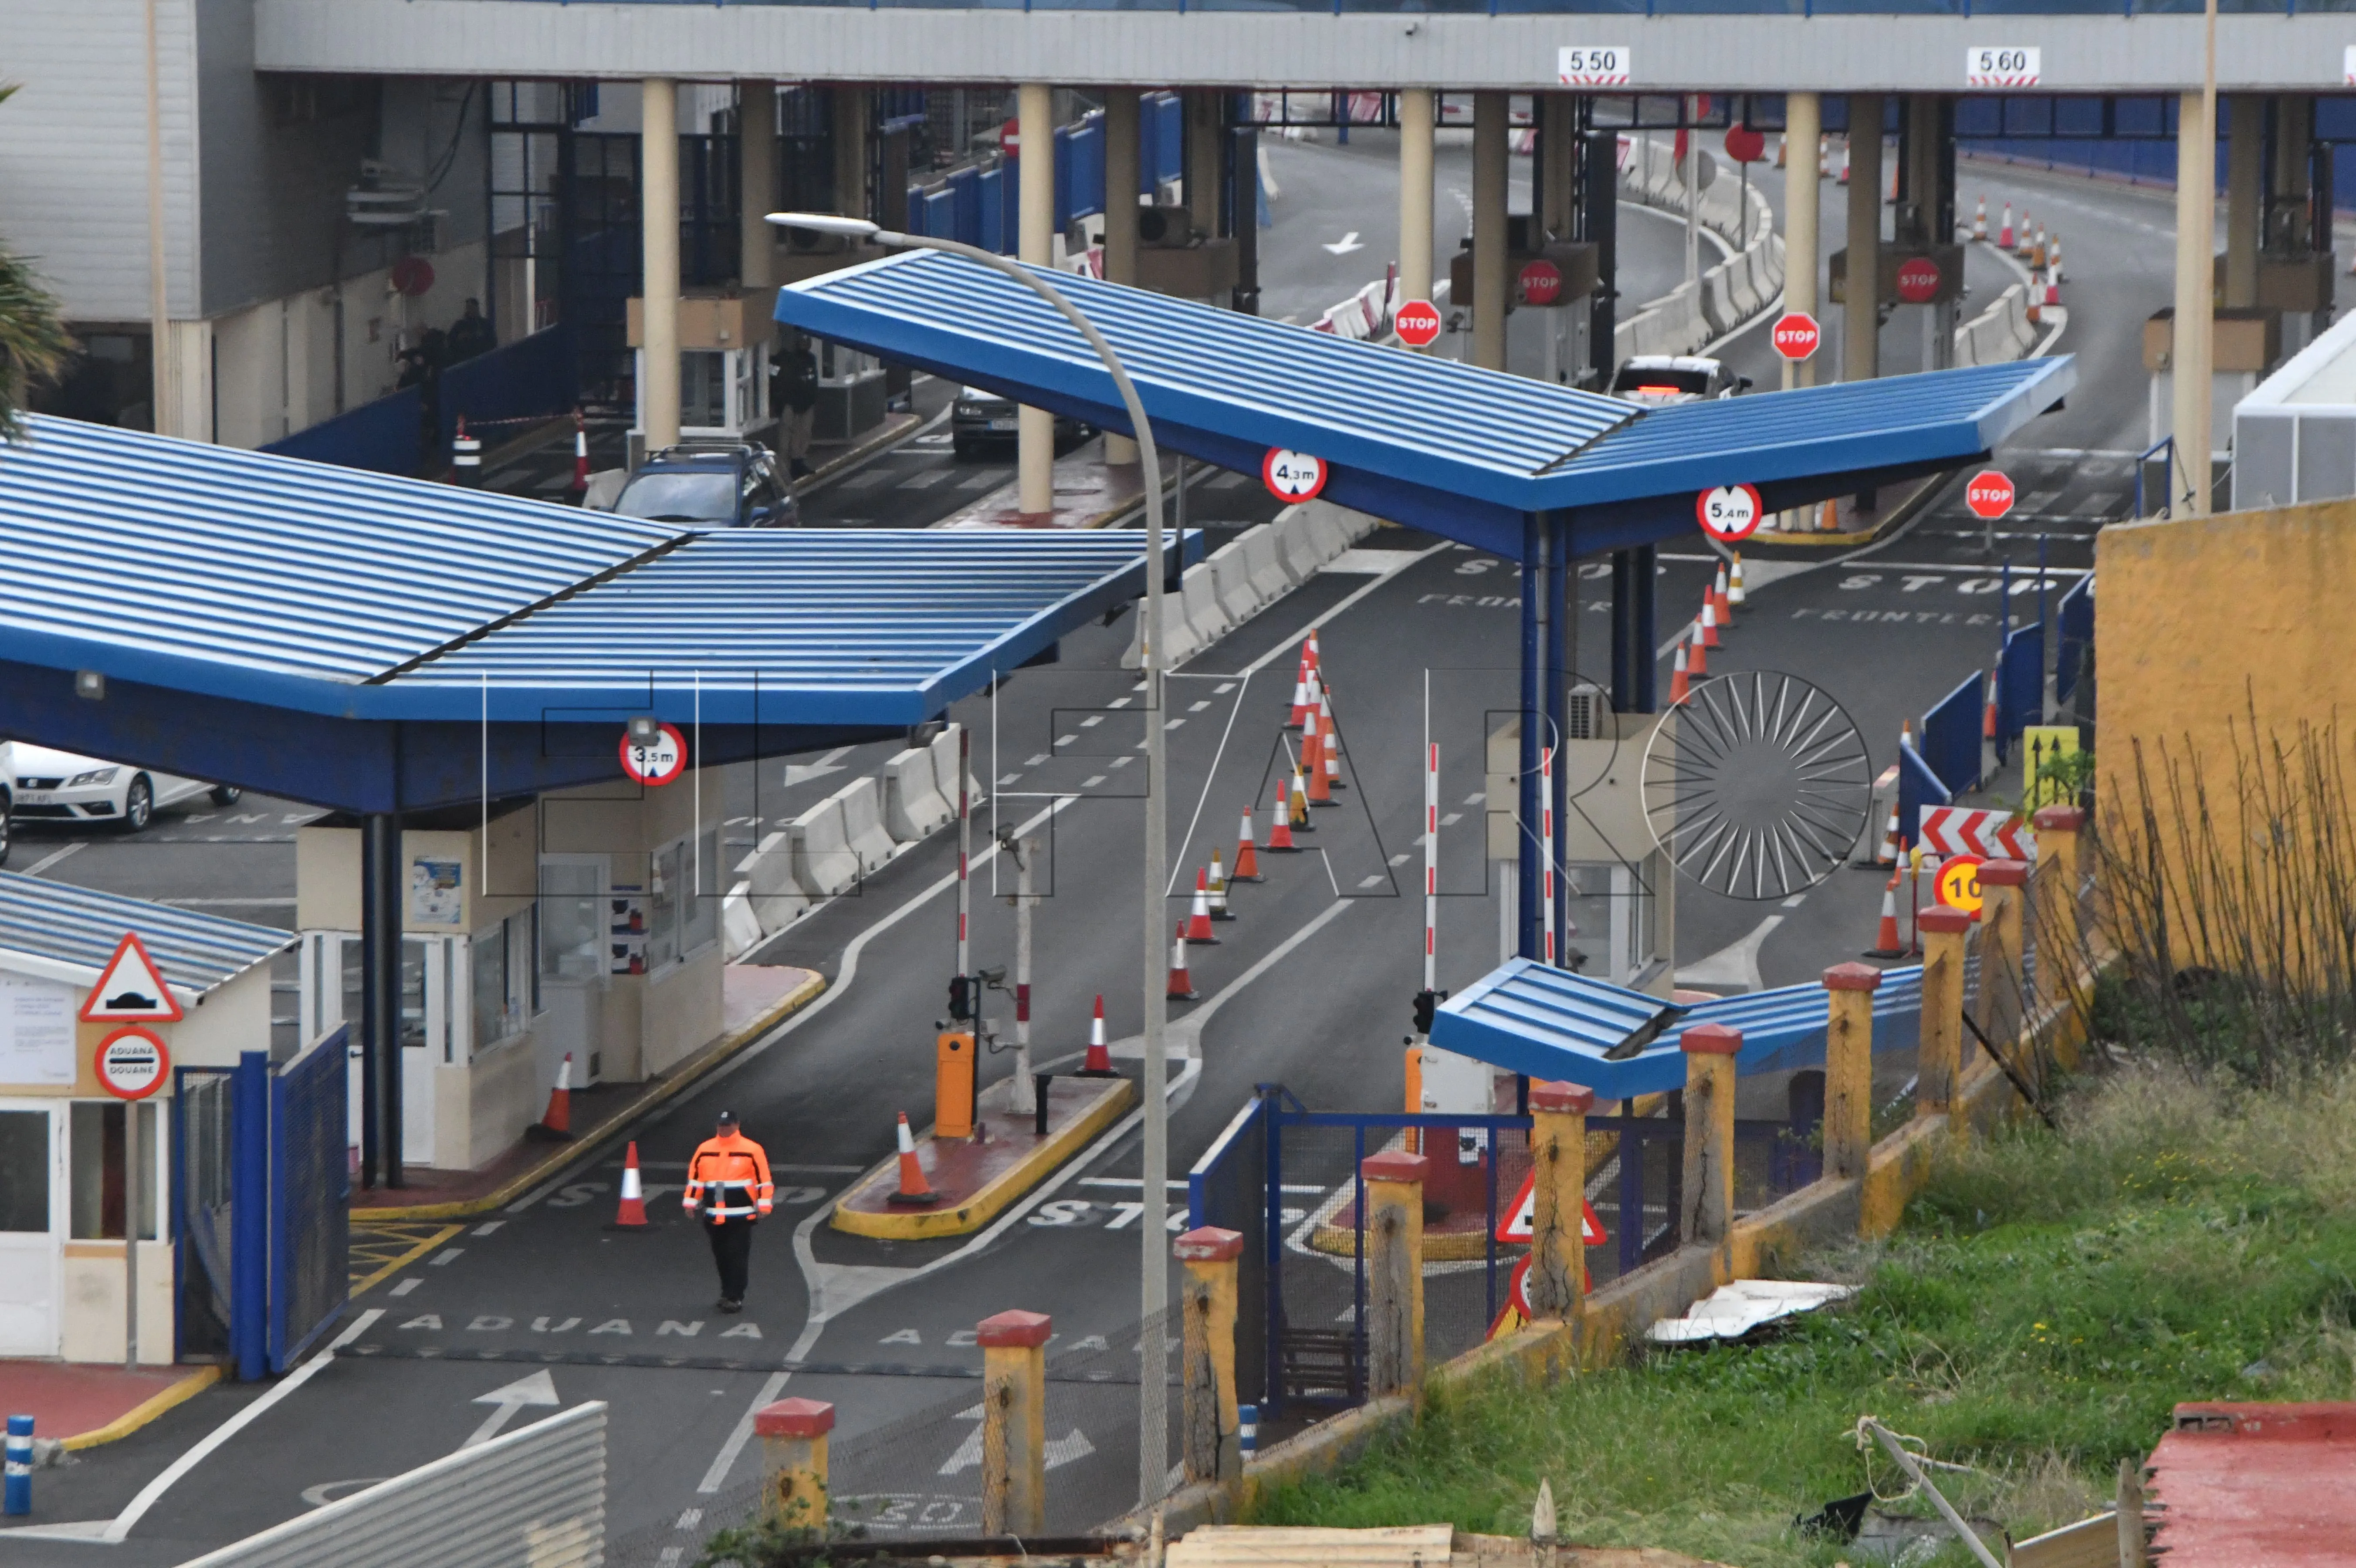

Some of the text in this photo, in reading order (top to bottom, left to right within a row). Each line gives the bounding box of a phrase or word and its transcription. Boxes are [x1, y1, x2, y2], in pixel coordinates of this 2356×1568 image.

[1571, 51, 1616, 74] 5,50
[1981, 51, 2026, 75] 5,60
[1523, 277, 1559, 289] STOP
[1900, 274, 1938, 287] STOP
[1398, 317, 1437, 330] STOP
[1777, 330, 1816, 343] STOP
[1970, 488, 2011, 501] STOP
[1838, 574, 2057, 595] STOP
[1949, 877, 1982, 899] 10
[397, 1314, 763, 1340] ADUANA
